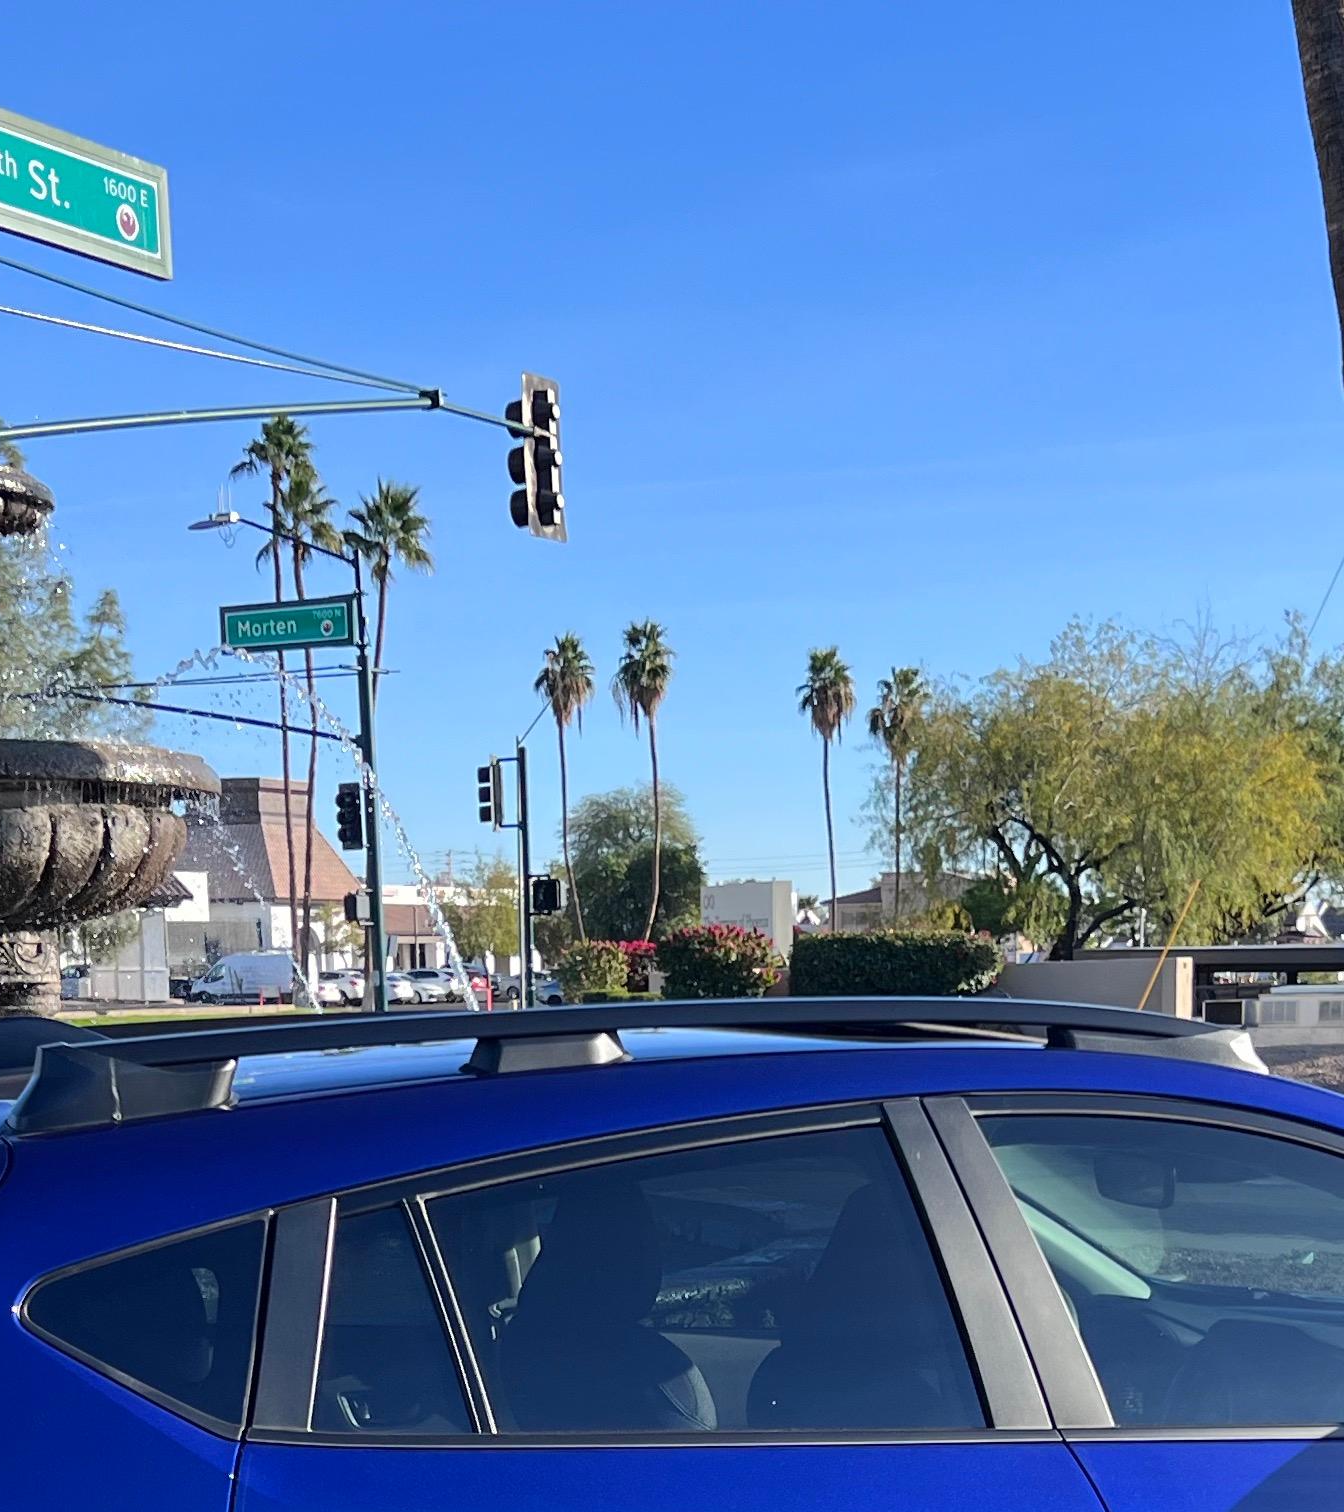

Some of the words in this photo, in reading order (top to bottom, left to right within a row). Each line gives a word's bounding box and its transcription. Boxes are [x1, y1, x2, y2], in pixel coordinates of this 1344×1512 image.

[28, 159, 71, 209] St.
[103, 175, 137, 204] 1600
[140, 189, 149, 208] E
[334, 608, 341, 618] N
[237, 619, 297, 638] Morten
